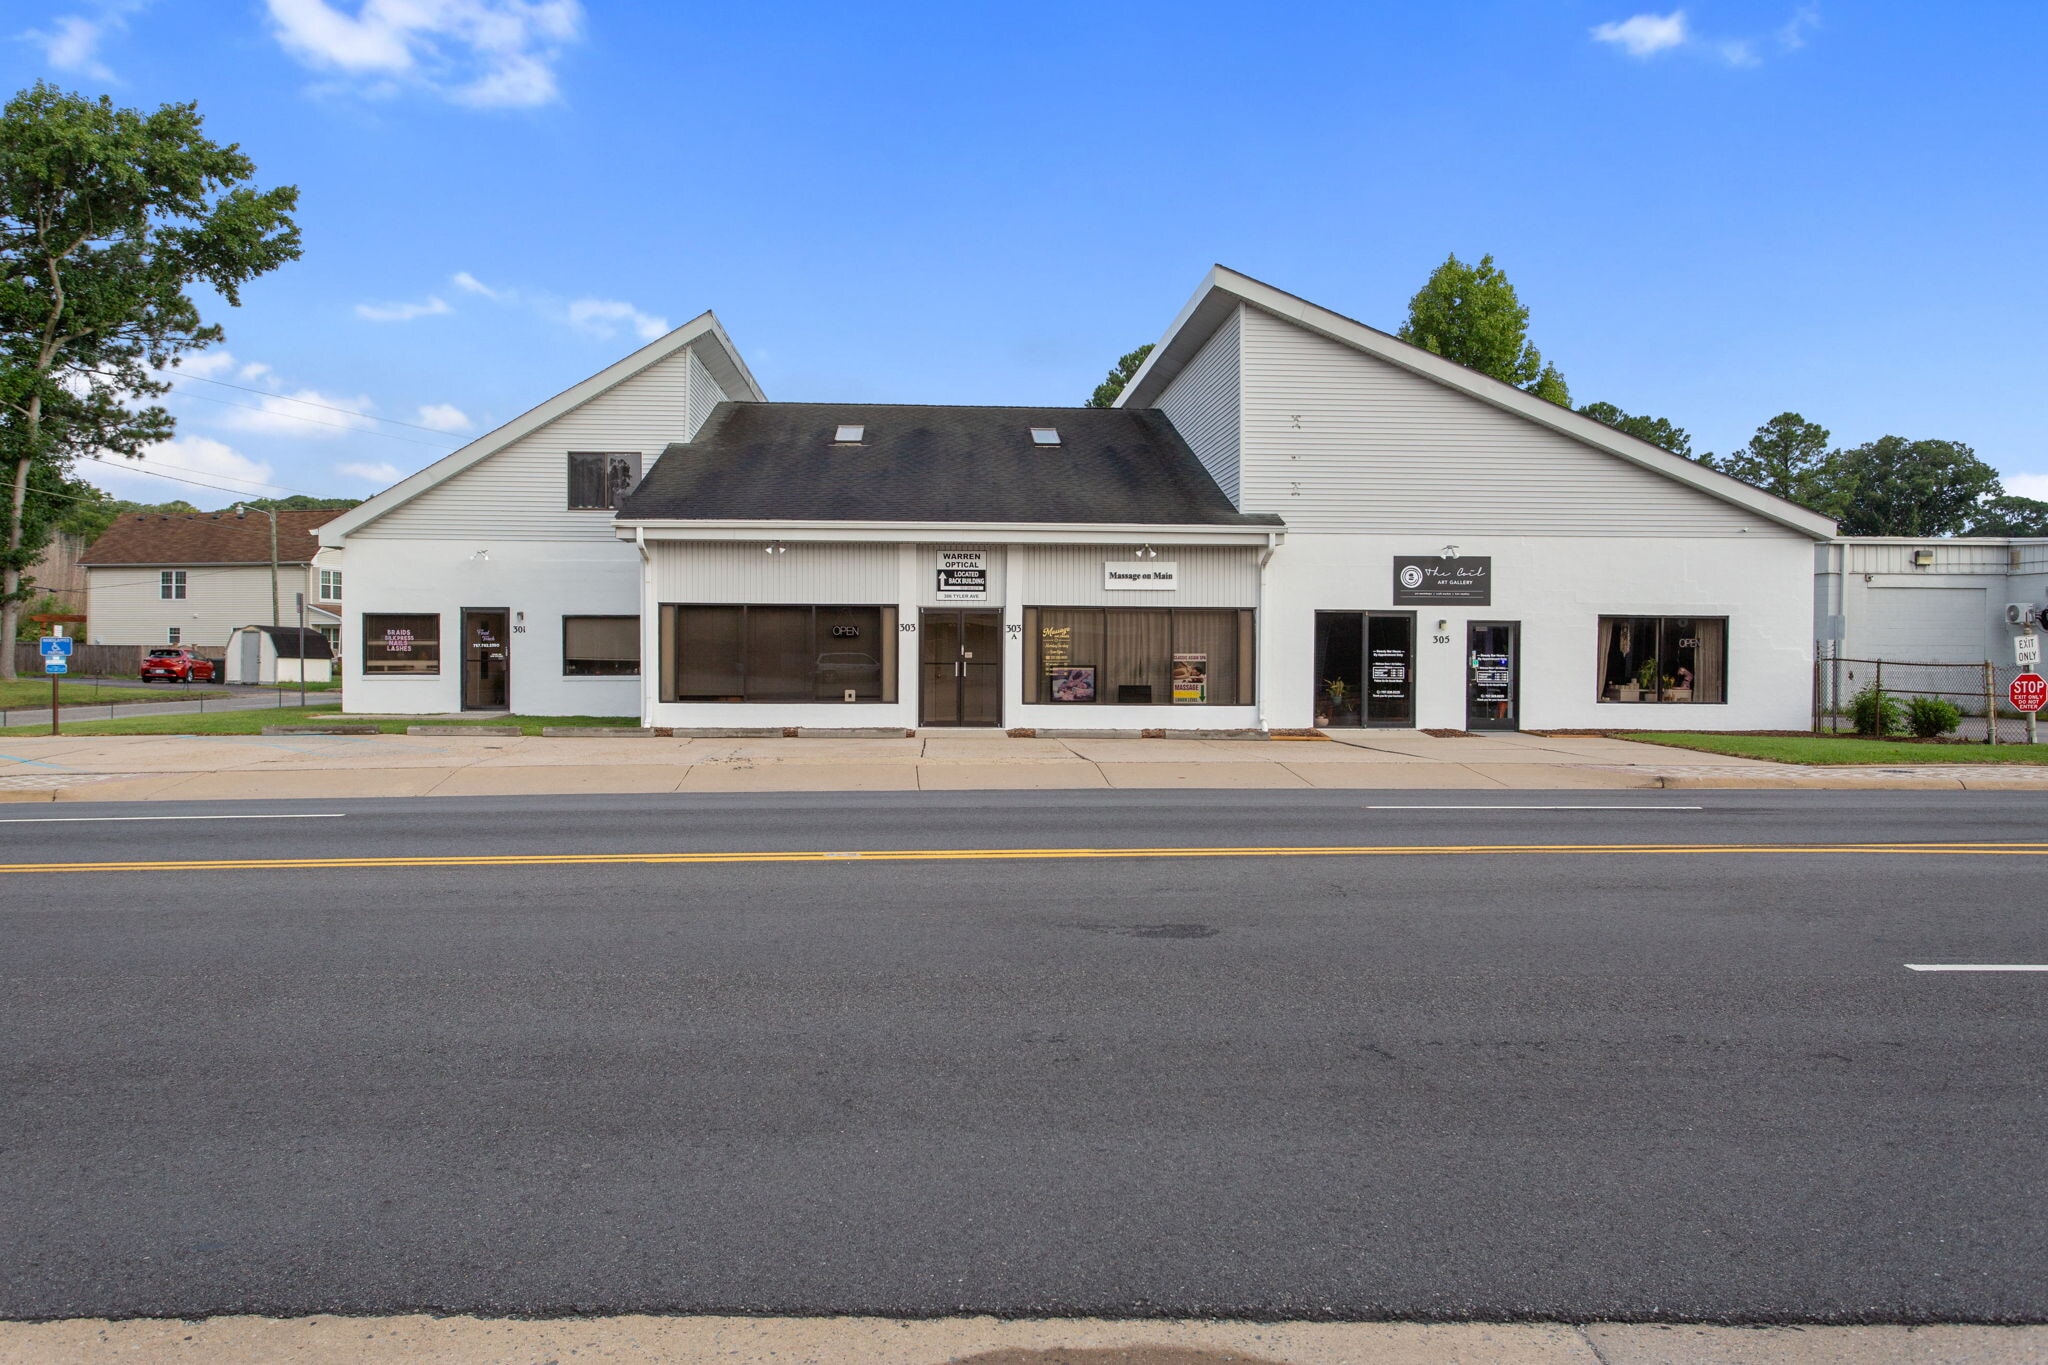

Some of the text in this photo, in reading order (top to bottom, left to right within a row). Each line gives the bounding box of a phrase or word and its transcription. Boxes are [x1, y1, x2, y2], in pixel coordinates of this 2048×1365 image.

[1109, 571, 1141, 581] Massage
[1153, 571, 1173, 580] Main
[512, 625, 526, 634] 301
[832, 625, 860, 636] OPEN
[899, 623, 917, 632] 303
[1005, 624, 1022, 633] 303
[1432, 635, 1450, 644] 305
[1679, 638, 1700, 648] OPEN
[2019, 639, 2034, 649] EXIT
[2018, 651, 2037, 661] ONLY
[2014, 681, 2044, 693] STOP
